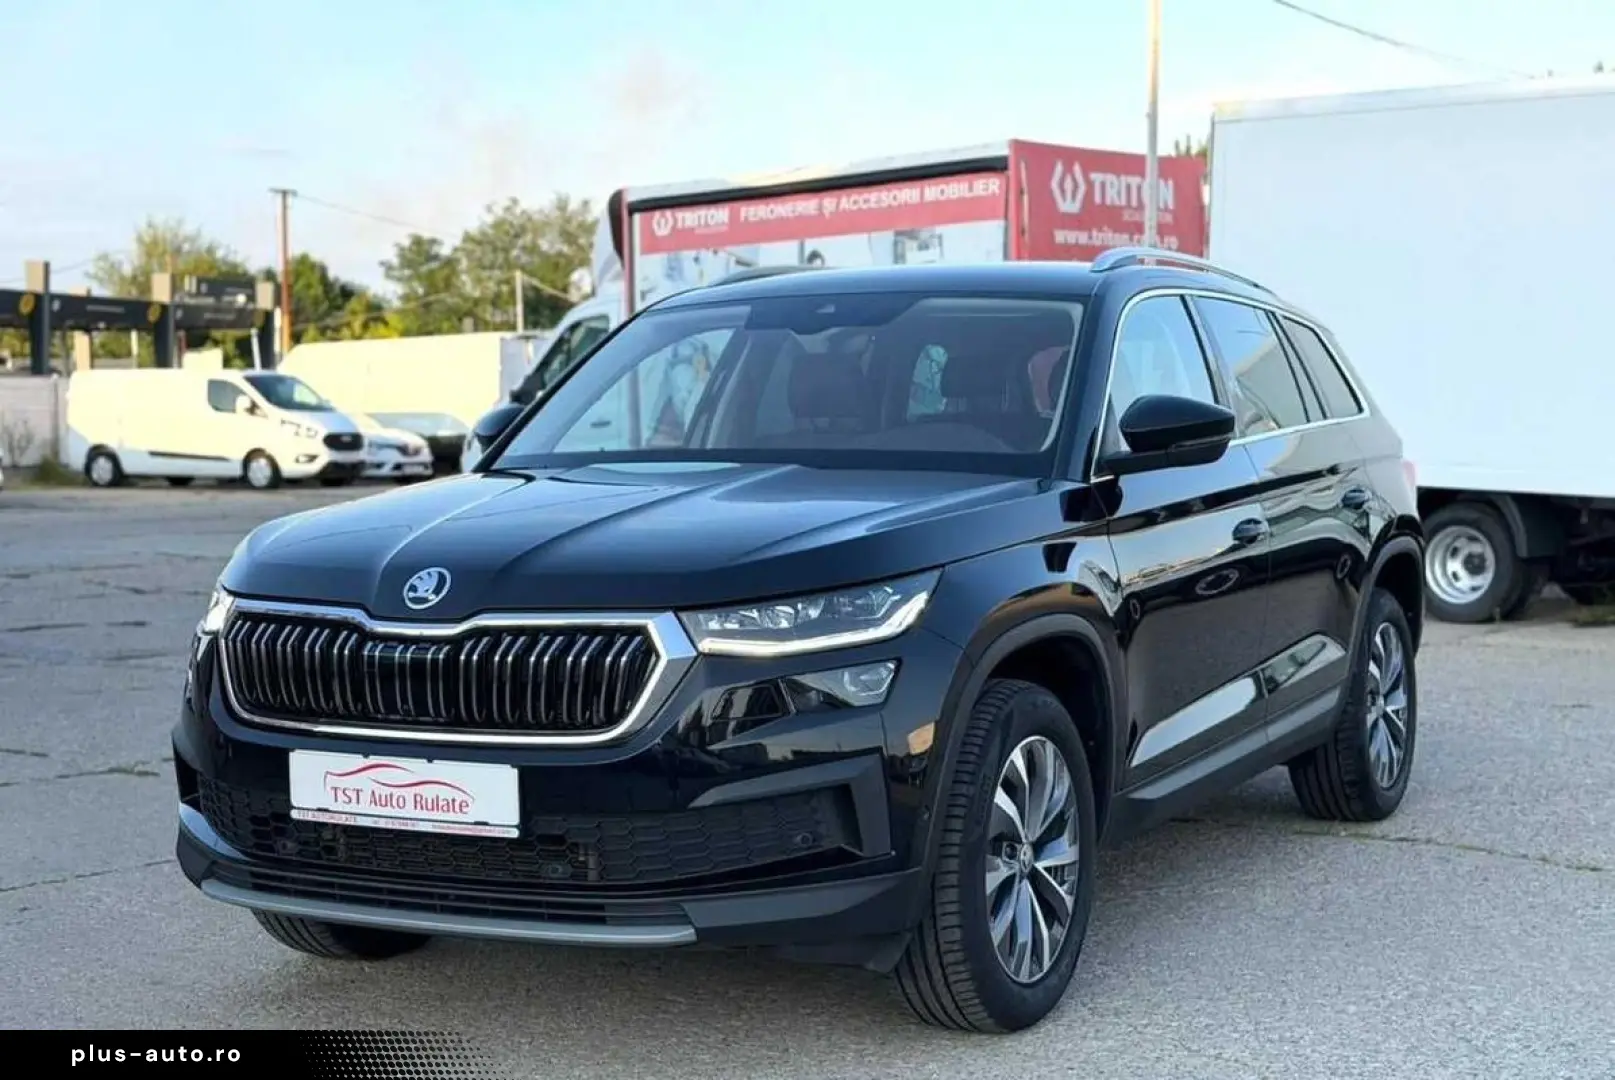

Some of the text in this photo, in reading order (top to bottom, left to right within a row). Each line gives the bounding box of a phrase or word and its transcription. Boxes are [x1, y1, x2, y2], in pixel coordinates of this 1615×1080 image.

[674, 207, 730, 229] TRITON
[739, 198, 820, 223] FERONERIE
[838, 187, 921, 212] ACCESORII
[924, 177, 1001, 203] MOBILIER
[331, 785, 471, 815] TST Auto Rulate
